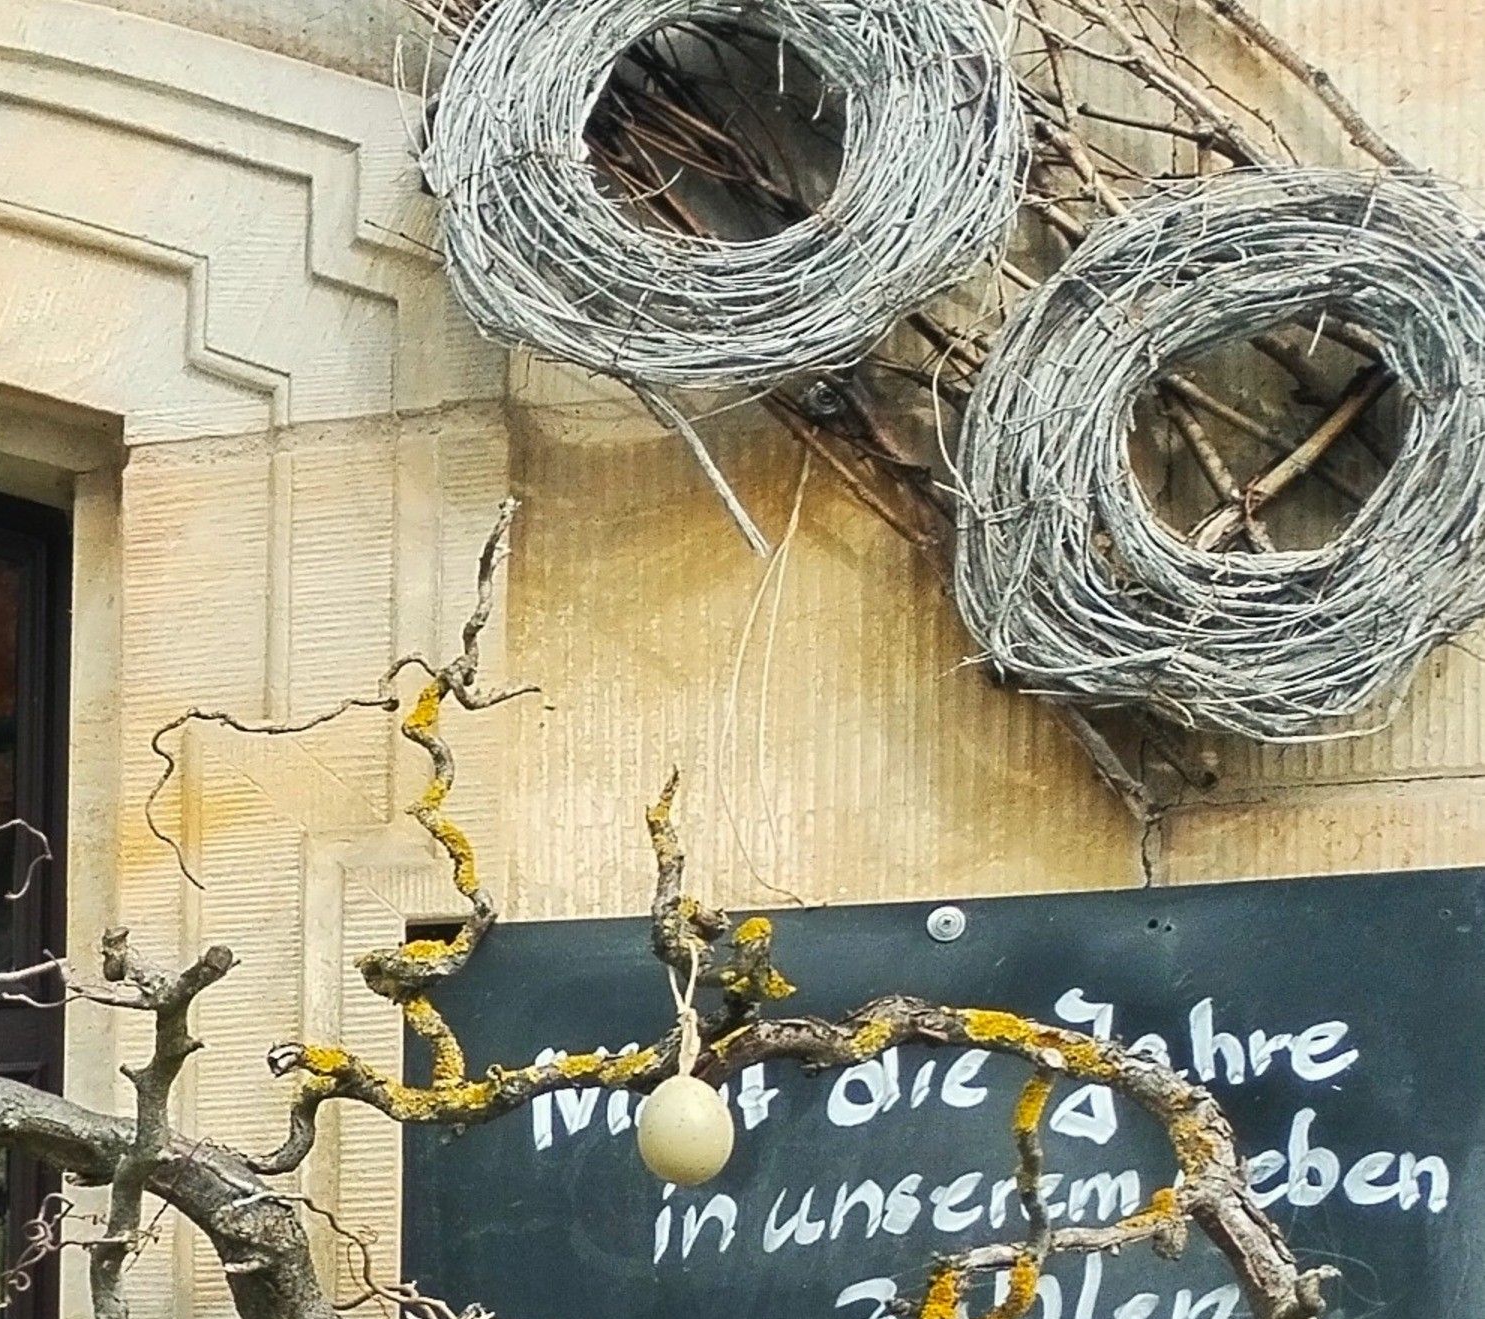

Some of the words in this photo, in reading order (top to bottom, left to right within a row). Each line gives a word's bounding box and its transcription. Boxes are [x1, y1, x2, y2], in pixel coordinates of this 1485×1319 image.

[827, 1046, 989, 1127] die
[653, 1182, 736, 1264] in
[762, 1169, 1142, 1253] unserem
[1174, 1107, 1450, 1213] eben
